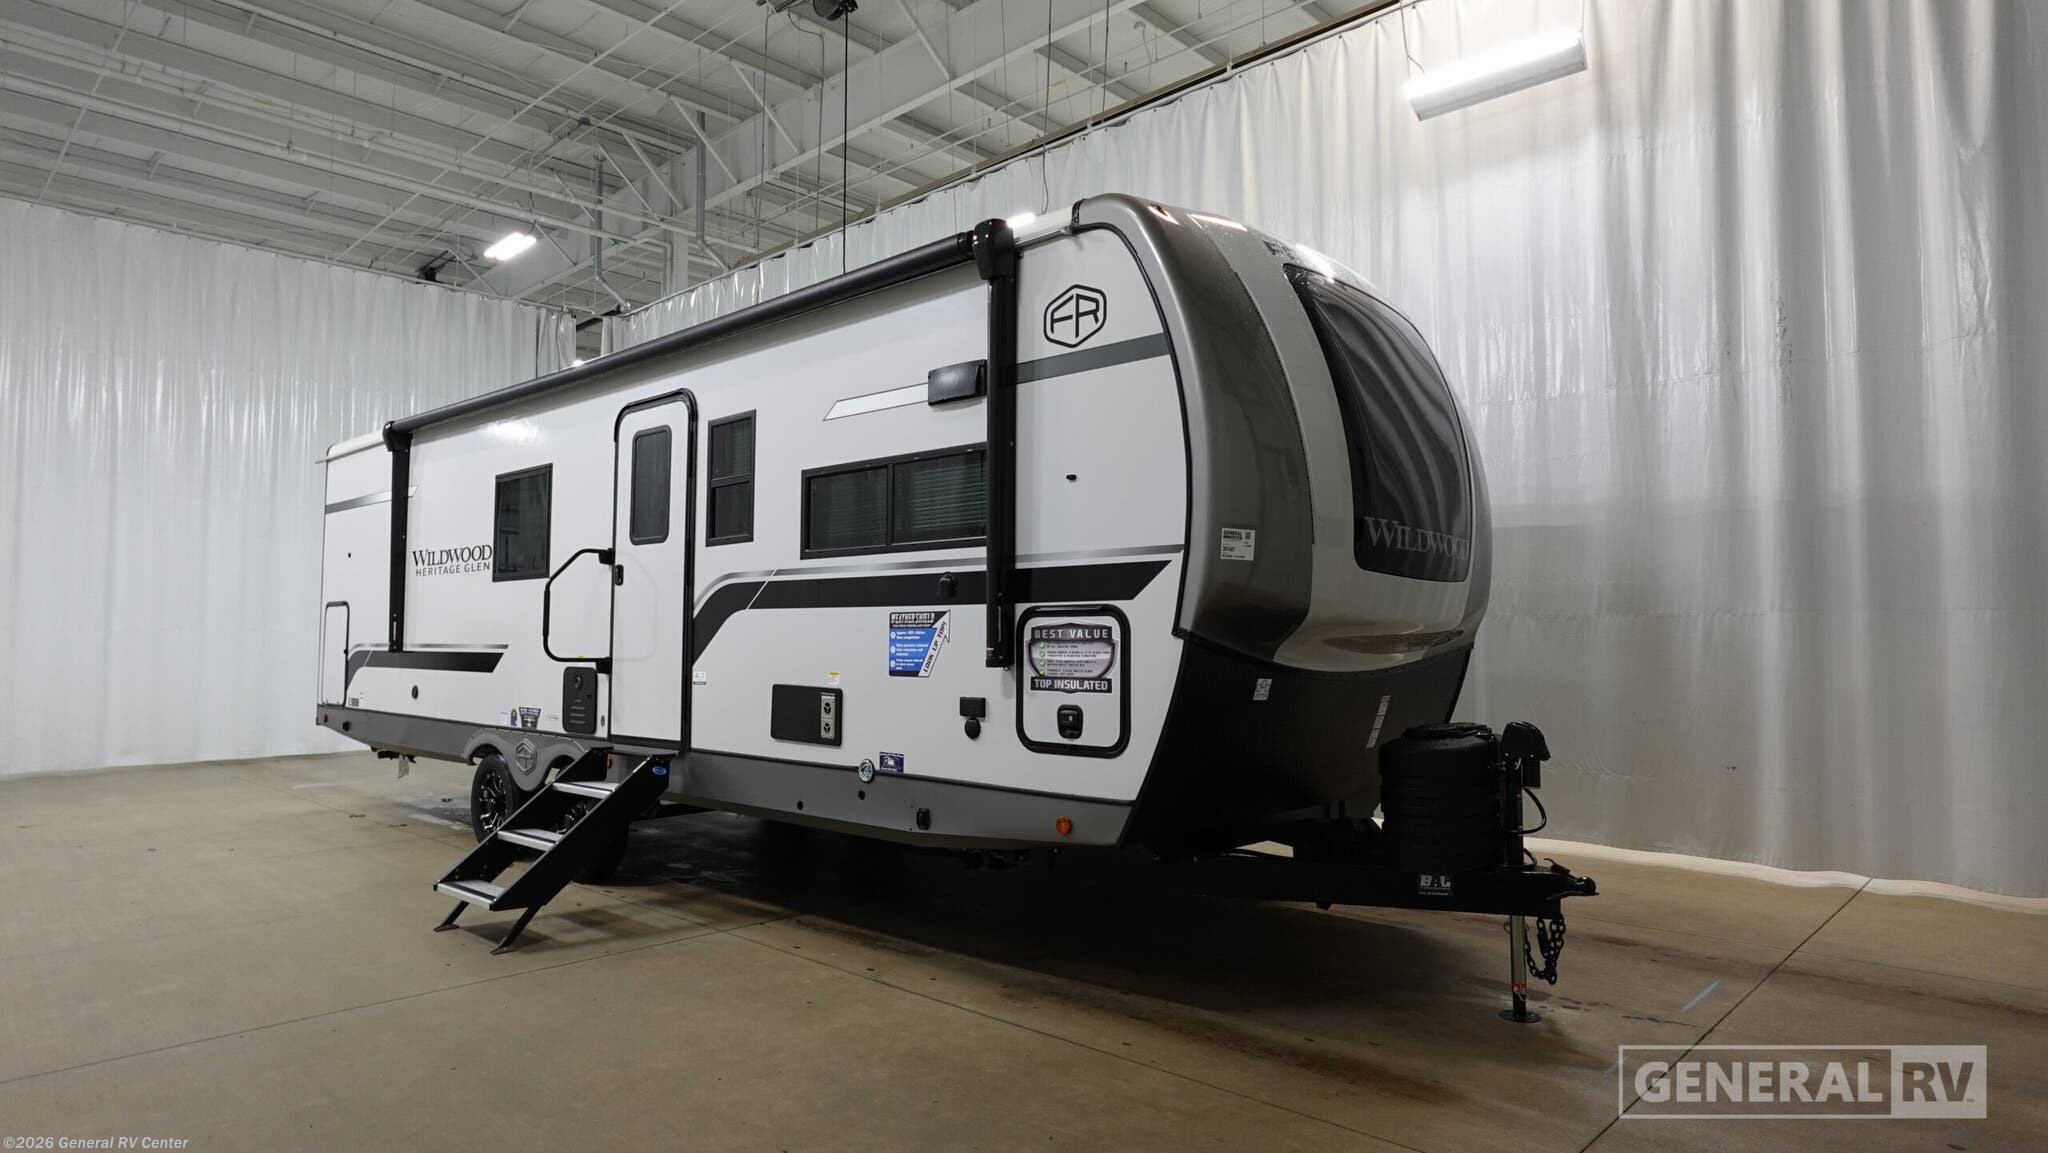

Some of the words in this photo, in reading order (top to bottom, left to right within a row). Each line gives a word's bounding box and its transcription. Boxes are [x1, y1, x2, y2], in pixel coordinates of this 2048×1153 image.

[412, 544, 493, 567] WILDWOOD
[415, 564, 461, 577] HERITAGE
[463, 561, 490, 573] GLEN
[1034, 629, 1063, 639] BEST
[1069, 628, 1109, 639] VALUE
[1034, 679, 1052, 689] TOP
[1054, 679, 1108, 691] INSULATED
